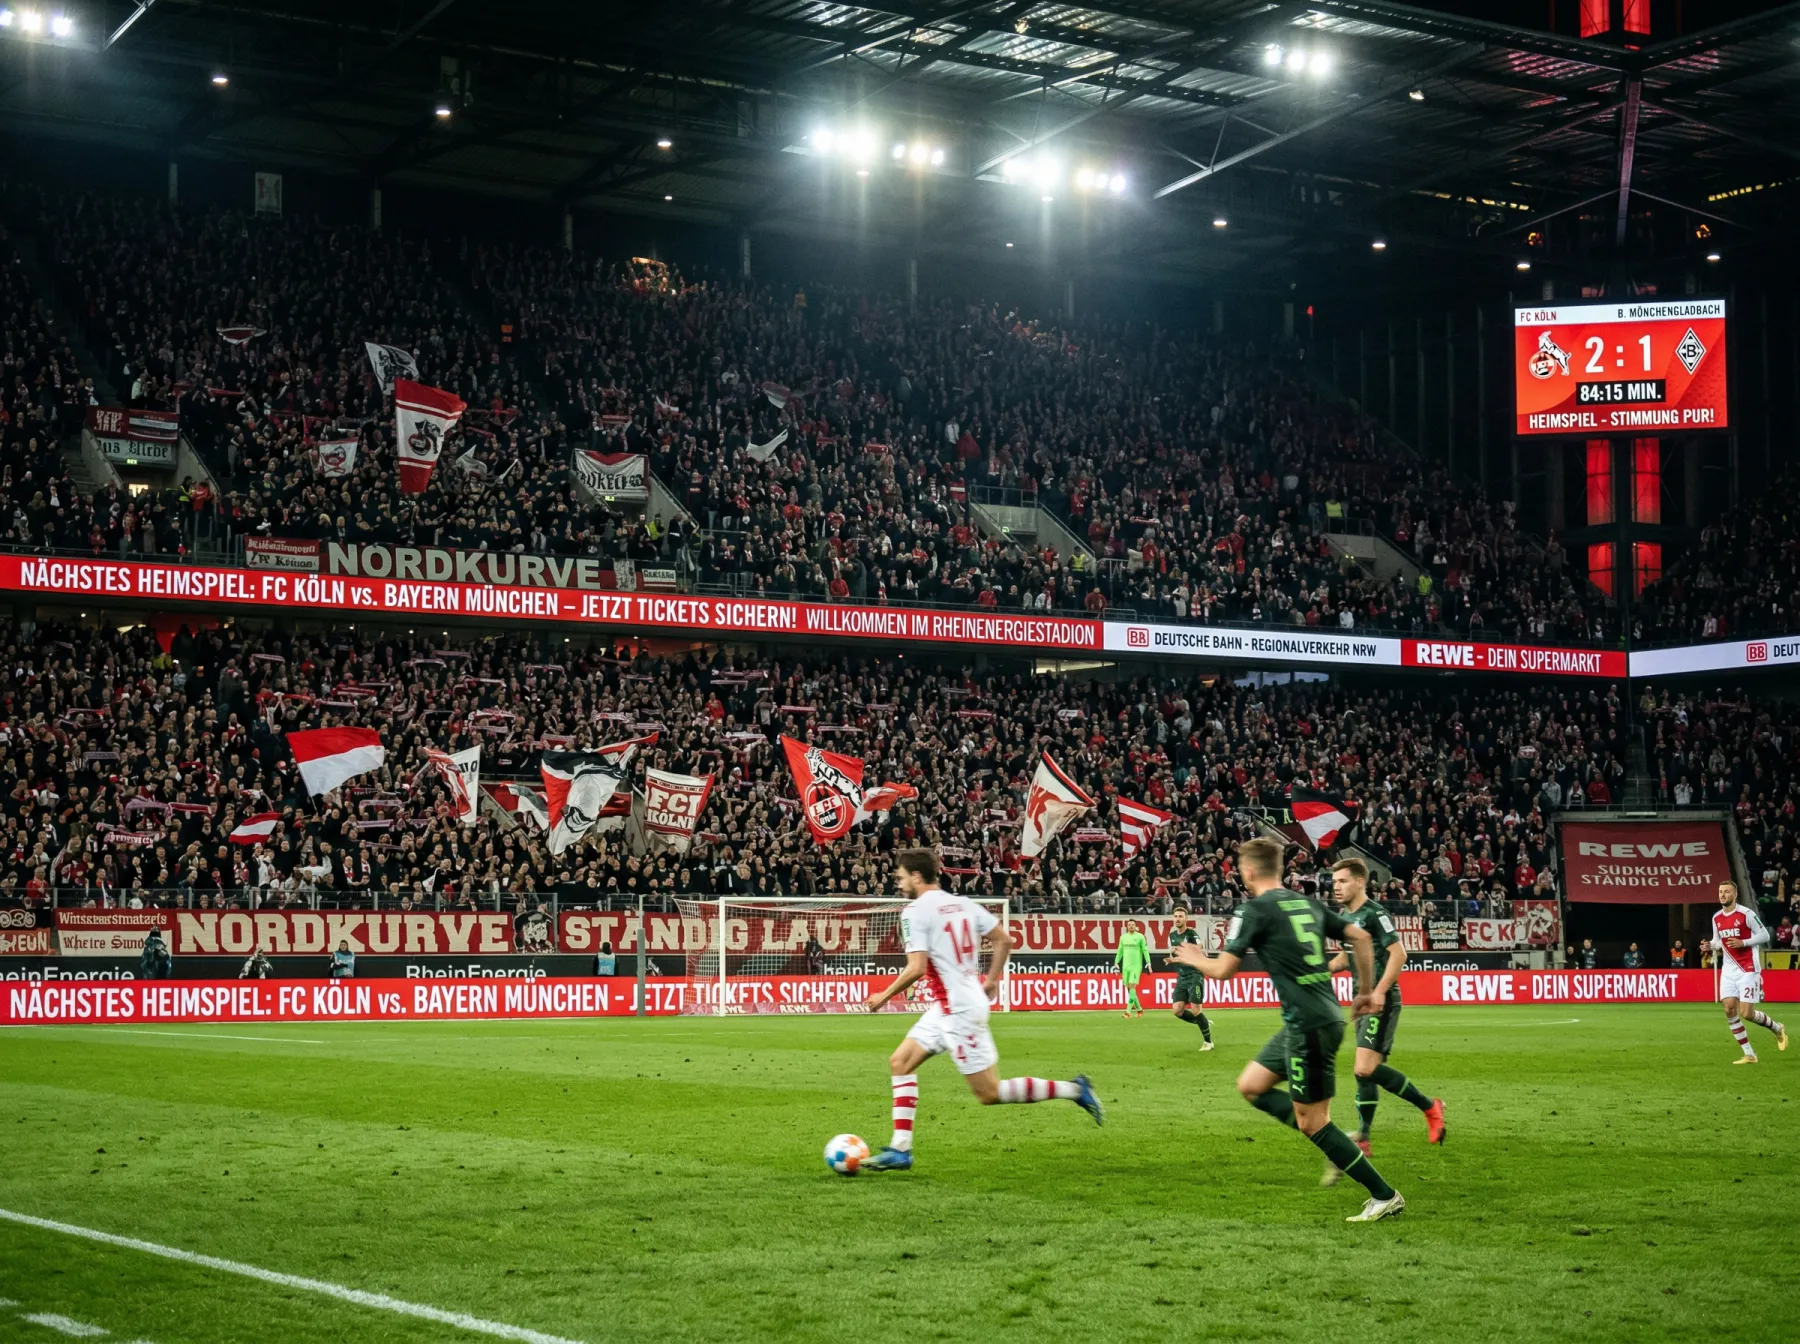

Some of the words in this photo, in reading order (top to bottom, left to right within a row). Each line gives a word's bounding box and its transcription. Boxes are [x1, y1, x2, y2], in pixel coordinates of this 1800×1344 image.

[1520, 312, 1532, 322] FC
[1534, 310, 1557, 321] KÖLN
[1617, 309, 1627, 319] B.
[1629, 304, 1721, 318] MÖNCHENGLADBACH
[1585, 336, 1604, 373] 2
[1638, 334, 1652, 371] 1
[1580, 384, 1623, 402] 84:15
[1627, 382, 1662, 400] MIN.
[1529, 413, 1598, 429] HEIMSPIEL
[1610, 410, 1679, 427] STIMMUNG
[1683, 408, 1715, 424] PUR!
[327, 541, 601, 590] NORDKURVE
[20, 558, 131, 592] NÄCHSTES
[137, 566, 256, 600] HEIMSPIEL:
[262, 576, 288, 600] FC
[294, 574, 345, 605] KÖLN
[351, 586, 378, 607] vs.
[384, 585, 459, 612] BAYERN
[465, 584, 558, 616] MÜNCHEN
[580, 595, 631, 620] JETZT
[637, 598, 710, 624] TICKETS
[715, 603, 797, 629] SICHERN!
[806, 608, 907, 636] WILLKOMMEN
[911, 615, 928, 636] IM
[932, 616, 1095, 646] RHEINENERGIESTADION
[1154, 632, 1210, 648] DEUTSCHE
[1212, 635, 1243, 650] BAHN
[1251, 638, 1350, 656] REGIONALVERKEHR
[1353, 644, 1377, 658] NRW
[1773, 643, 1800, 658] DEUT
[1417, 643, 1474, 667] REWE
[1488, 647, 1516, 669] DEIN
[1520, 651, 1601, 674] SUPERMARKT
[1578, 841, 1710, 858] REWE
[1666, 873, 1713, 886] LAUT
[176, 912, 508, 953] NORDKURVE
[565, 909, 748, 951] STÄNDIG
[763, 918, 869, 951] LAUT
[943, 917, 975, 965] 14
[1009, 914, 1197, 951] SÜDKURV
[1289, 913, 1324, 967] 5
[1466, 921, 1493, 942] FC
[406, 964, 547, 979] RheinEnergie
[1401, 959, 1479, 970] einEnergie
[10, 981, 135, 1019] NÄCHSTES
[142, 986, 272, 1017] HEIMSPIEL:
[279, 986, 306, 1015] FC
[313, 979, 371, 1015] KÖLN
[378, 992, 406, 1014] vs.
[414, 984, 497, 1013] BAYERN
[505, 977, 609, 1013] MÜNCHEN
[629, 983, 688, 1011] JETZT
[779, 981, 869, 1004] SICHERN!
[1442, 974, 1515, 1001] REWE
[1532, 974, 1569, 1000] DEIN
[1573, 973, 1679, 999] SUPERMARKT
[1366, 1016, 1380, 1035] 3
[1290, 1057, 1304, 1082] 5
